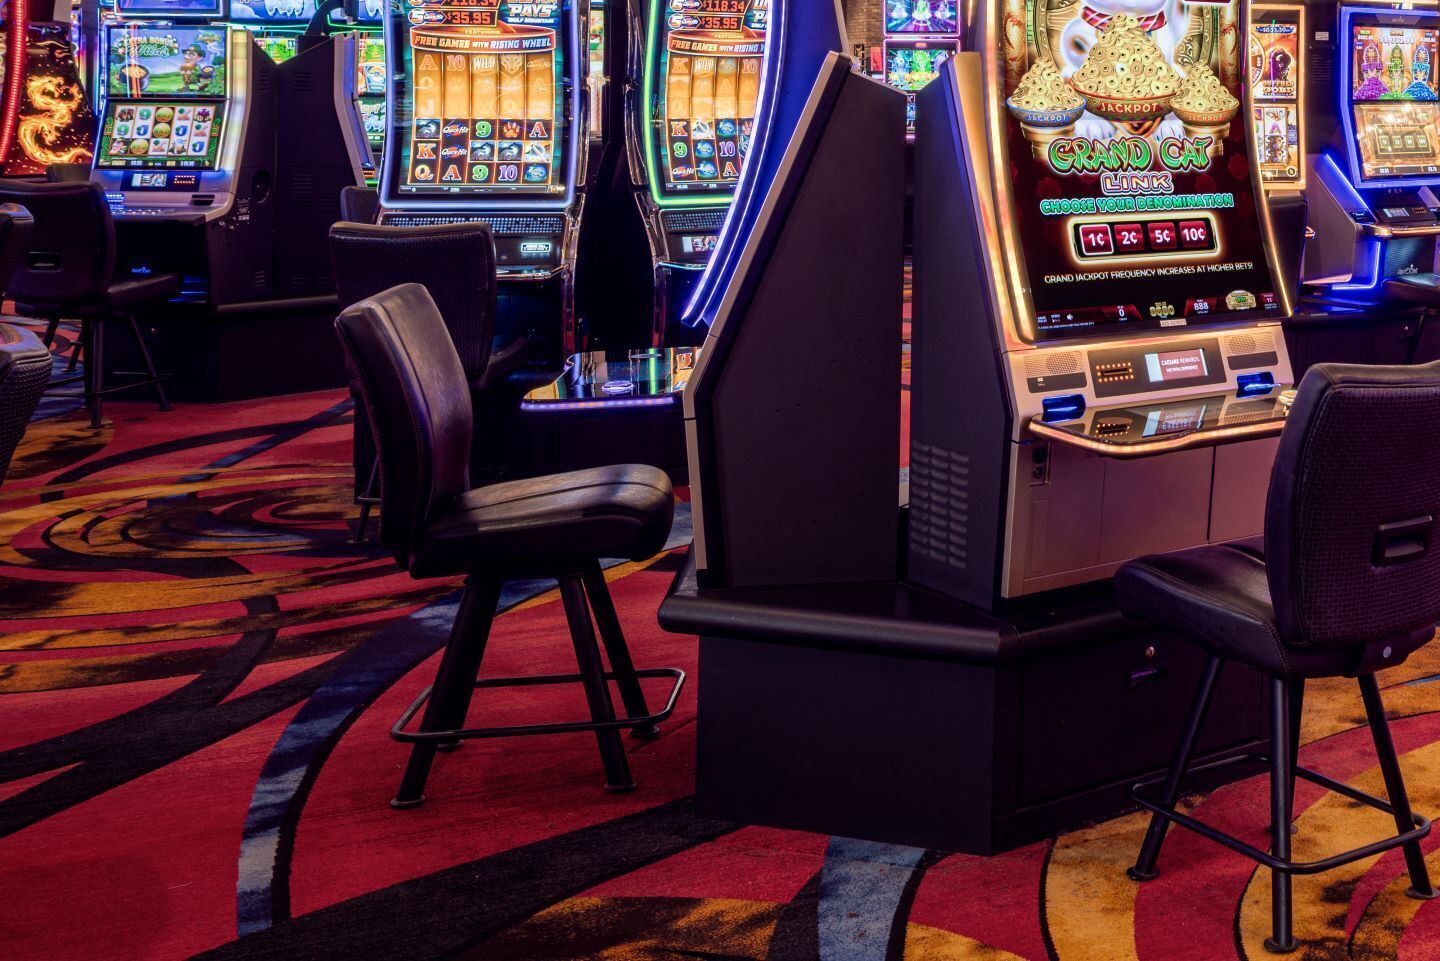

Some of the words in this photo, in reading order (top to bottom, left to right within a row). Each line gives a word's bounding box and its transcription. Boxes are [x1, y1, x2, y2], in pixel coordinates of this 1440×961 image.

[507, 4, 558, 17] PAYS
[702, 0, 745, 12] $118.34
[446, 11, 491, 24] $35.95
[701, 17, 738, 29] $35.95
[415, 36, 437, 46] FREE
[438, 37, 470, 48] GAMES
[490, 40, 520, 49] RISING
[521, 38, 551, 48] WHEEL
[670, 40, 691, 48] FREE
[691, 42, 718, 52] GAMES
[733, 43, 759, 53] RISING
[419, 54, 438, 71] A
[446, 55, 466, 71] 10
[473, 54, 496, 71] WILD
[671, 58, 689, 74] K
[742, 58, 758, 74] 10
[1101, 102, 1158, 114] JACKPOT
[1028, 114, 1068, 122] JACKPOT
[1188, 114, 1224, 122] JACKPOT
[475, 121, 492, 138] 9
[529, 121, 548, 138] A
[670, 121, 688, 137] K
[417, 142, 437, 159] K
[672, 141, 688, 158] 9
[719, 141, 736, 157] 10
[1048, 136, 1152, 174] GRAND
[1159, 136, 1214, 173] CAT
[414, 164, 434, 181] Q
[442, 164, 462, 181] A
[472, 164, 489, 181] 9
[498, 164, 518, 181] 10
[722, 161, 739, 177] A
[1101, 171, 1174, 196] LINK
[1040, 197, 1096, 215] CHOOSE
[1096, 196, 1136, 212] YOUR
[1136, 193, 1235, 211] DENOMINATION
[1088, 232, 1105, 247] 1¢
[1120, 231, 1138, 245] 2¢
[1154, 229, 1171, 243] 5¢
[1182, 227, 1206, 241] 10¢
[1044, 274, 1074, 284] GRAND
[1075, 272, 1109, 282] JACKPOT
[1110, 268, 1156, 279] FREQUENCY
[1157, 265, 1196, 276] INCREASES
[1196, 265, 1206, 273] AT
[1207, 263, 1235, 272] HIGHER
[1235, 261, 1254, 270] BETS!
[1118, 308, 1125, 317] 0
[1193, 302, 1209, 311] 888
[1161, 358, 1180, 366] CAESARS
